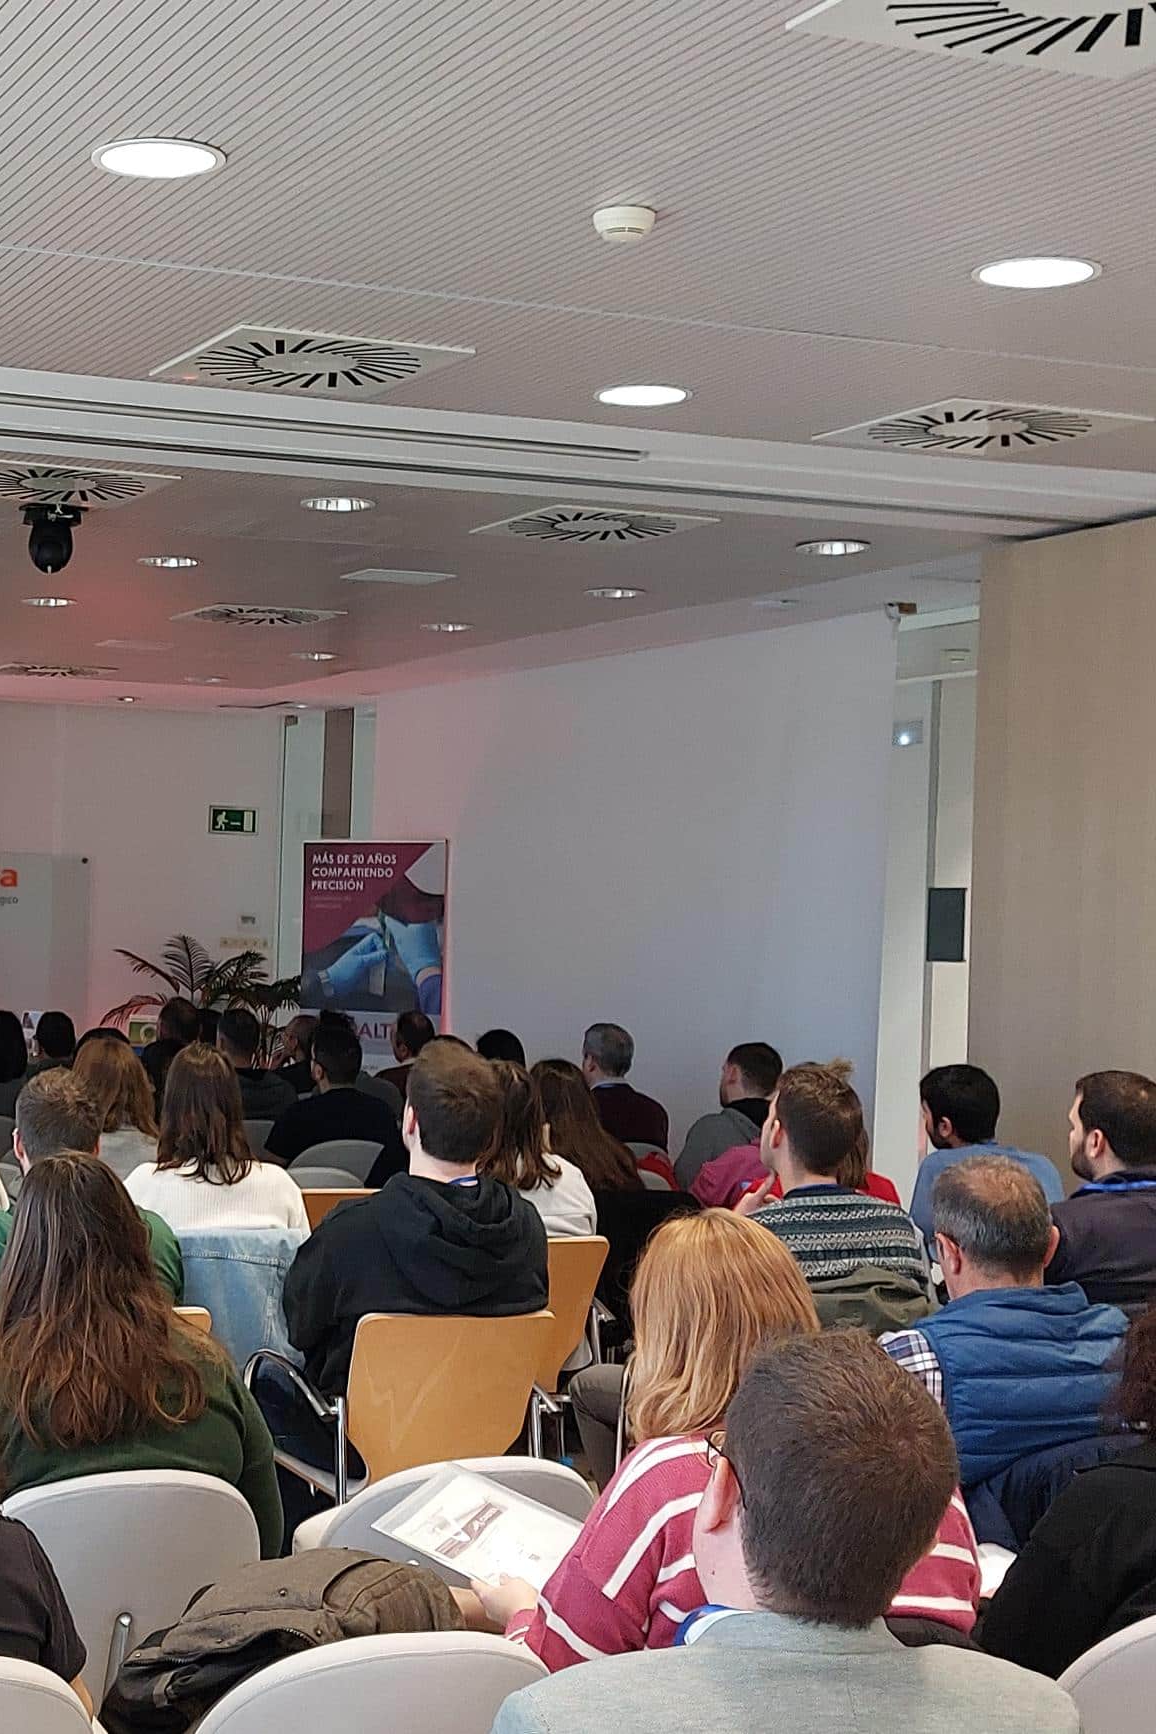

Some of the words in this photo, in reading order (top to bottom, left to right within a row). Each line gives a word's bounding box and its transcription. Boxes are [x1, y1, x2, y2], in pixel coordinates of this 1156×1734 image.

[312, 850, 334, 865] MÁS
[337, 854, 349, 865] DE
[352, 854, 364, 865] 20
[367, 852, 397, 865] AÑOS
[311, 867, 394, 879] COMPARTIENDO
[311, 878, 364, 891] PRECISIÓN
